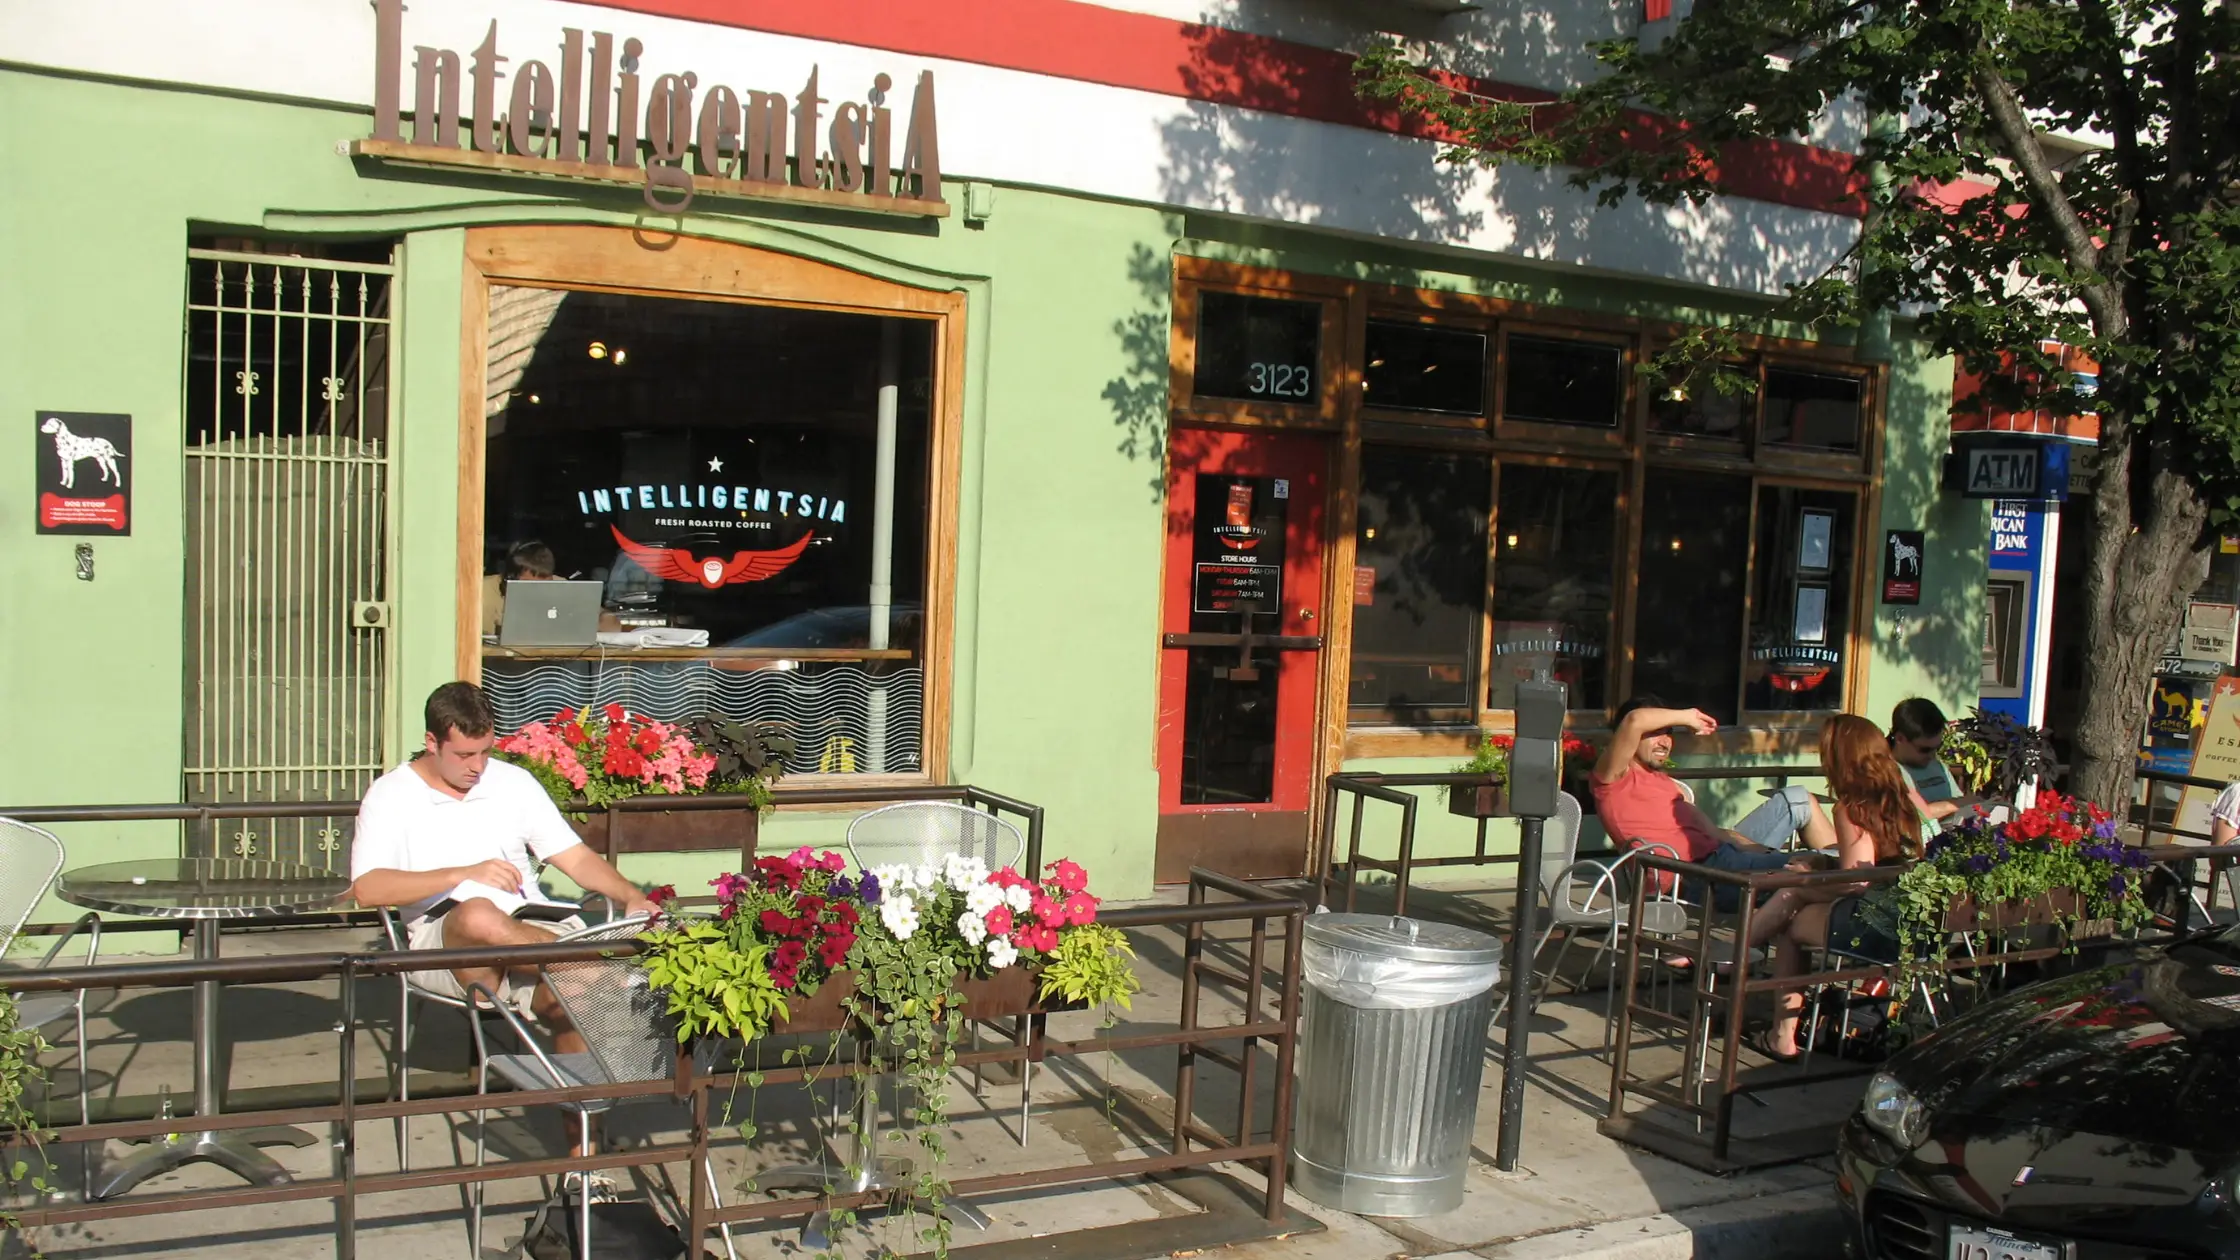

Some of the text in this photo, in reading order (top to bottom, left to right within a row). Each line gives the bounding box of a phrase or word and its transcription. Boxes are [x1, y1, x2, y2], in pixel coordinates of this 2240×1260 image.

[1250, 362, 1310, 397] 3123
[1971, 453, 2035, 490] ATM
[578, 484, 846, 524] INTELLIGENTSIA
[655, 518, 771, 530] FRESH ROASTED COFFEE
[1990, 517, 2025, 533] RICAN
[1994, 533, 2028, 551] BANK
[1221, 555, 1258, 564] STORE HOURS
[1753, 647, 1839, 663] INTELLIGENTSIA
